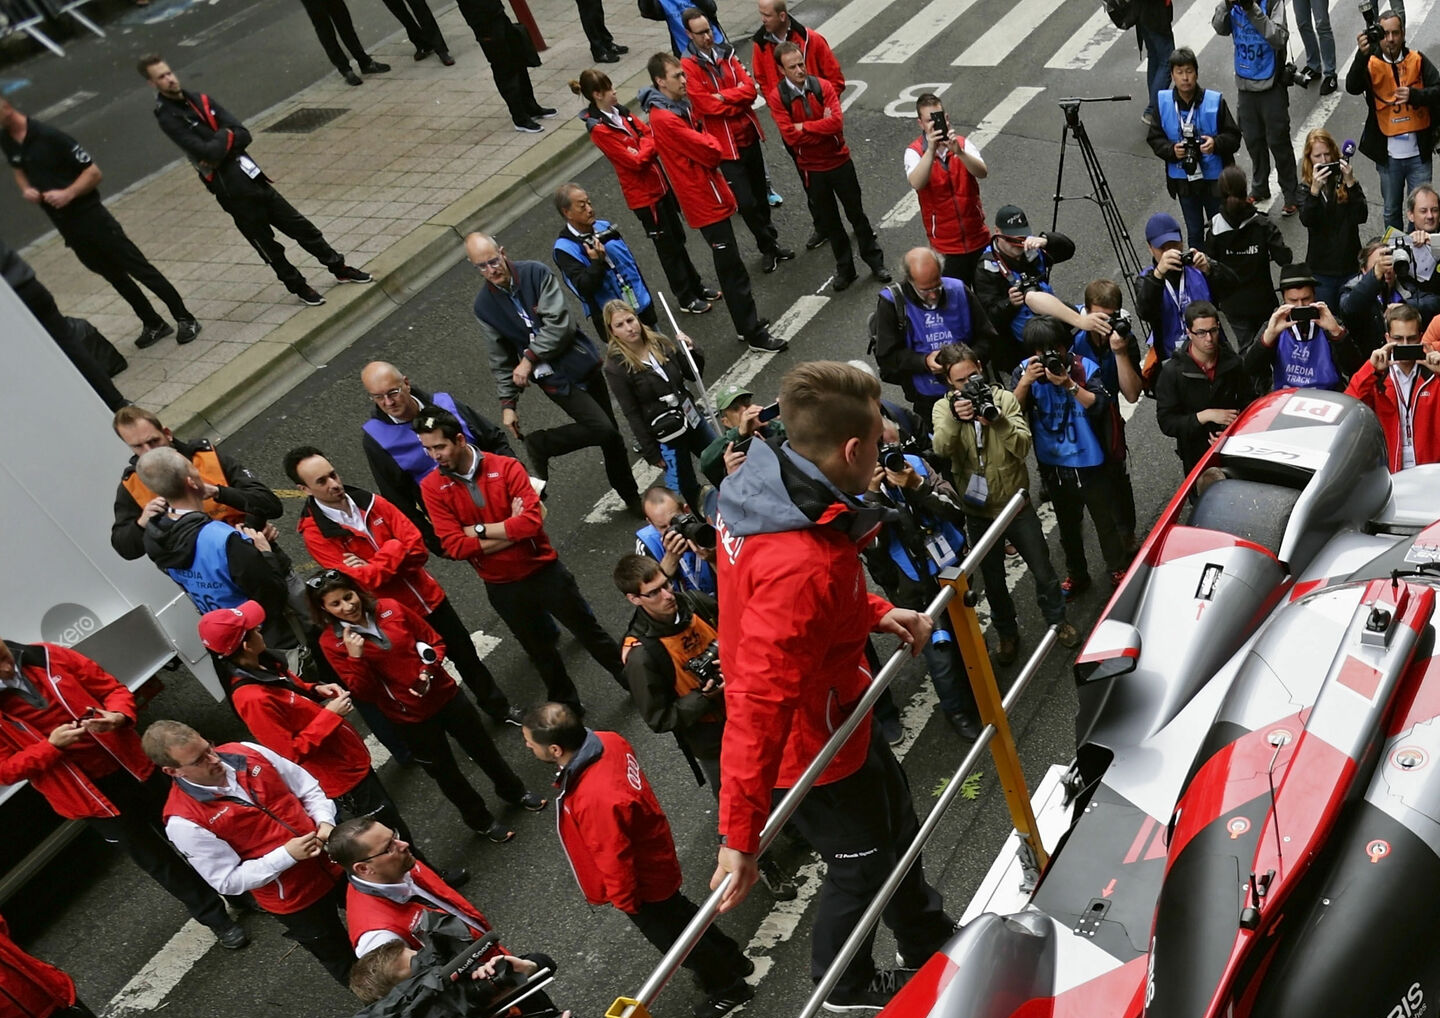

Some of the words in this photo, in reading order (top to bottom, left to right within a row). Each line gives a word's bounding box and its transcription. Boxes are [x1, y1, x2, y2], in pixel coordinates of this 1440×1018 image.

[925, 330, 953, 343] MEDIA
[1286, 363, 1314, 377] MEDIA
[1287, 375, 1311, 385] TRACK
[1295, 401, 1332, 417] P1
[457, 958, 474, 974] Audi
[472, 941, 493, 958] Sport
